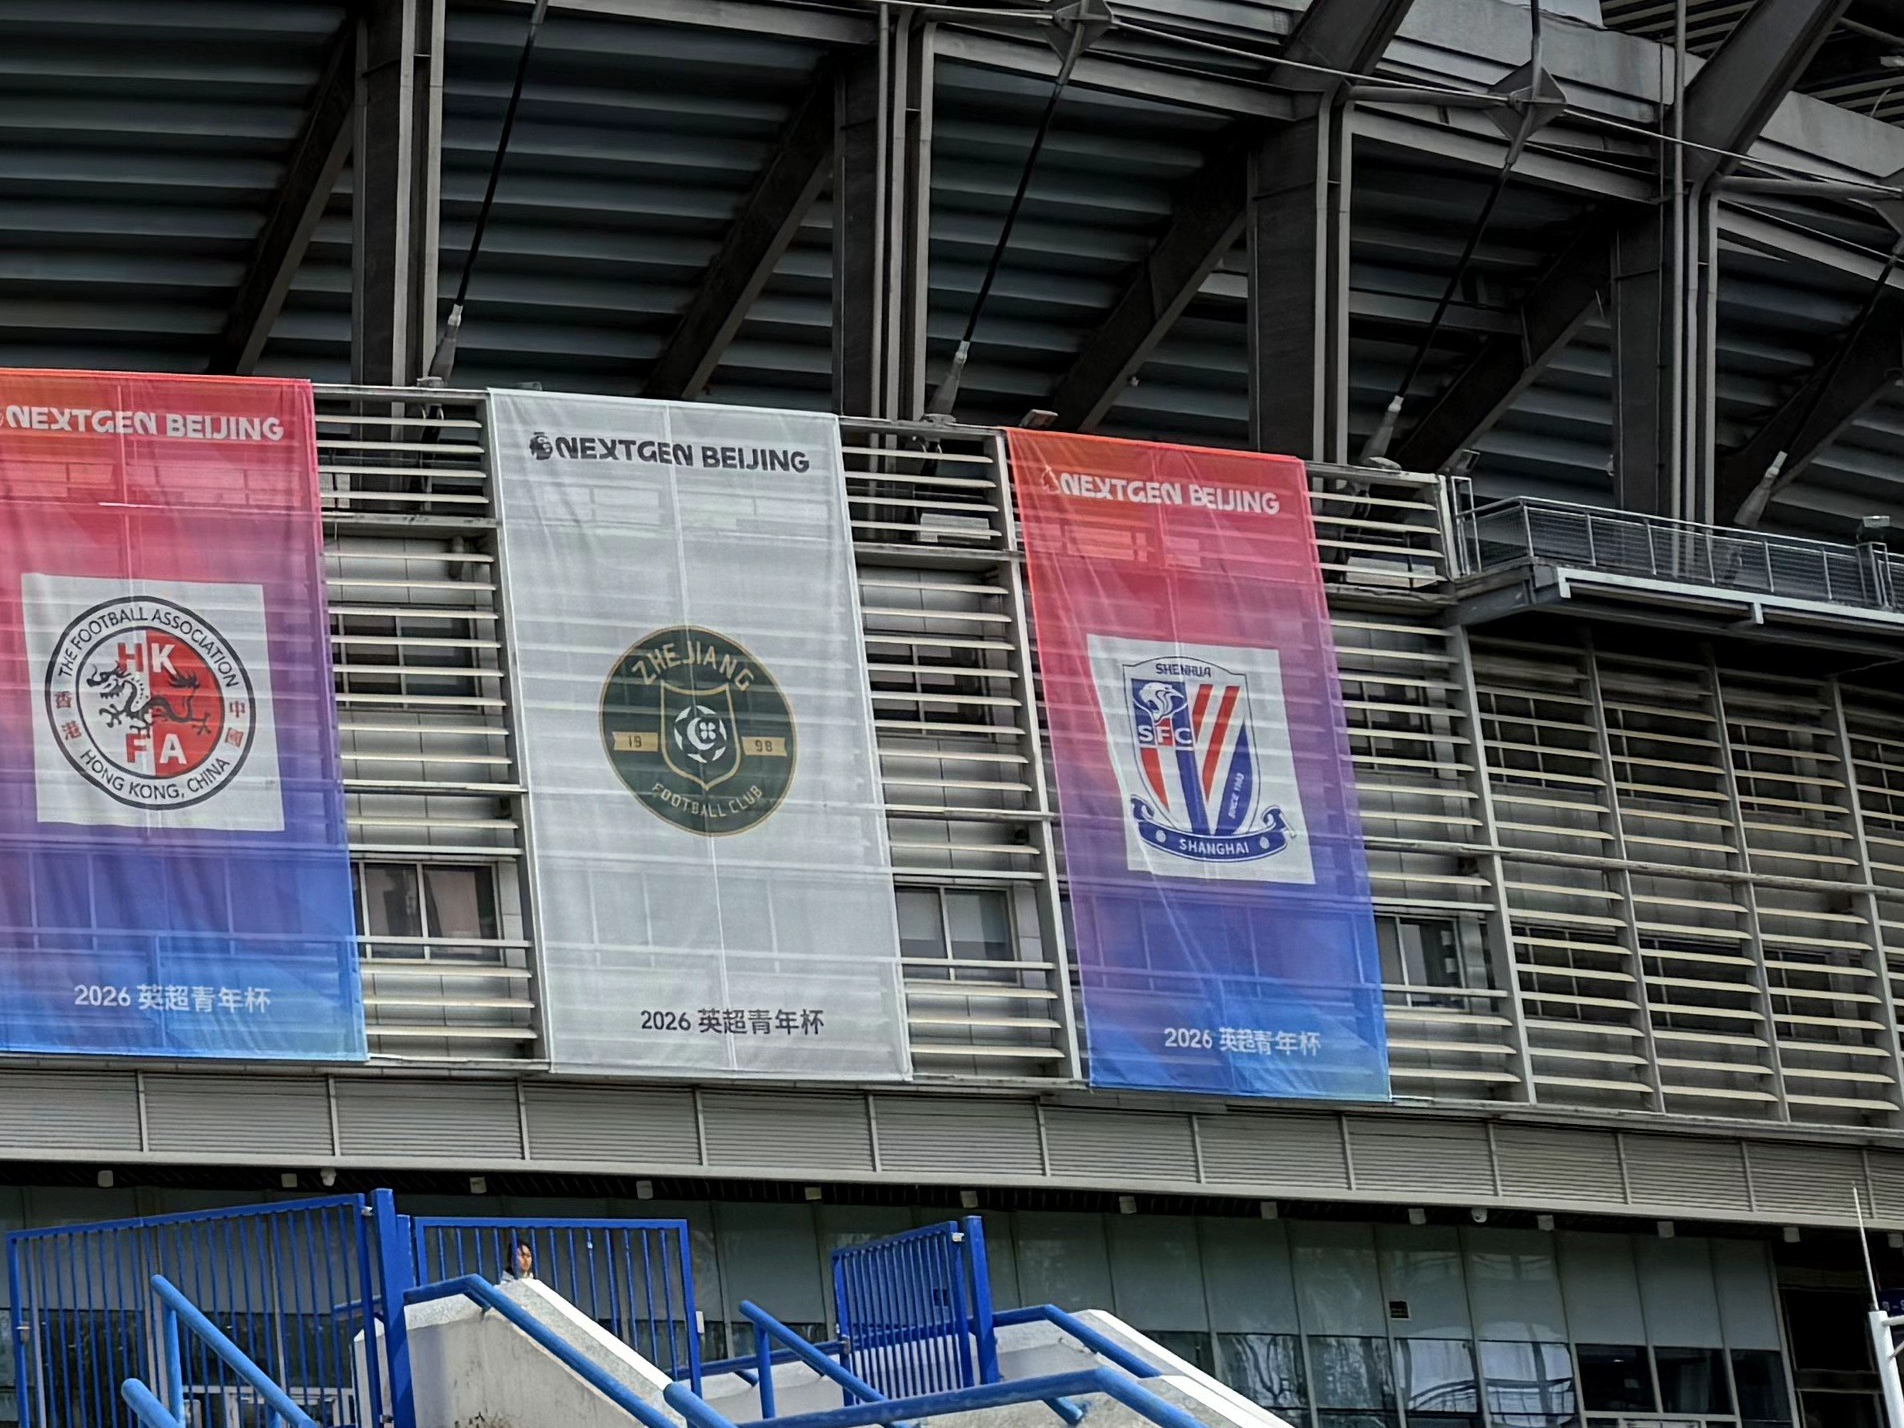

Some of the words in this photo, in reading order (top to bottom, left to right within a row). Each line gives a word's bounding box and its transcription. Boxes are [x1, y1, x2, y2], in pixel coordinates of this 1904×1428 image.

[6, 404, 157, 436] NEXTGEN
[166, 413, 284, 442] BEIJING
[555, 436, 693, 466] NEXTGEN
[701, 445, 810, 473] BEIJING
[1060, 472, 1183, 505] NEXTGEN
[1189, 483, 1280, 515] BEIJING
[58, 649, 79, 678] THE
[71, 607, 148, 651] FOOTBALL
[151, 608, 240, 688] ASSOCIATION
[117, 642, 176, 675] HK
[631, 640, 754, 692] ZHEJIANG
[125, 733, 187, 765] FA
[628, 735, 642, 748] 19
[1137, 725, 1192, 745] SFC
[79, 749, 124, 791] HONG
[128, 780, 185, 800] KONG,
[186, 757, 231, 794] CHINA
[651, 782, 726, 818] FOOTBALL
[728, 785, 763, 814] CLUB
[1179, 839, 1249, 856] SHANGHAI
[74, 984, 131, 1007] 2026
[137, 983, 272, 1014] 英超青年杯
[641, 1010, 691, 1031] 2026
[697, 1008, 824, 1035] 英超青年杯
[1164, 1027, 1212, 1049] 2026
